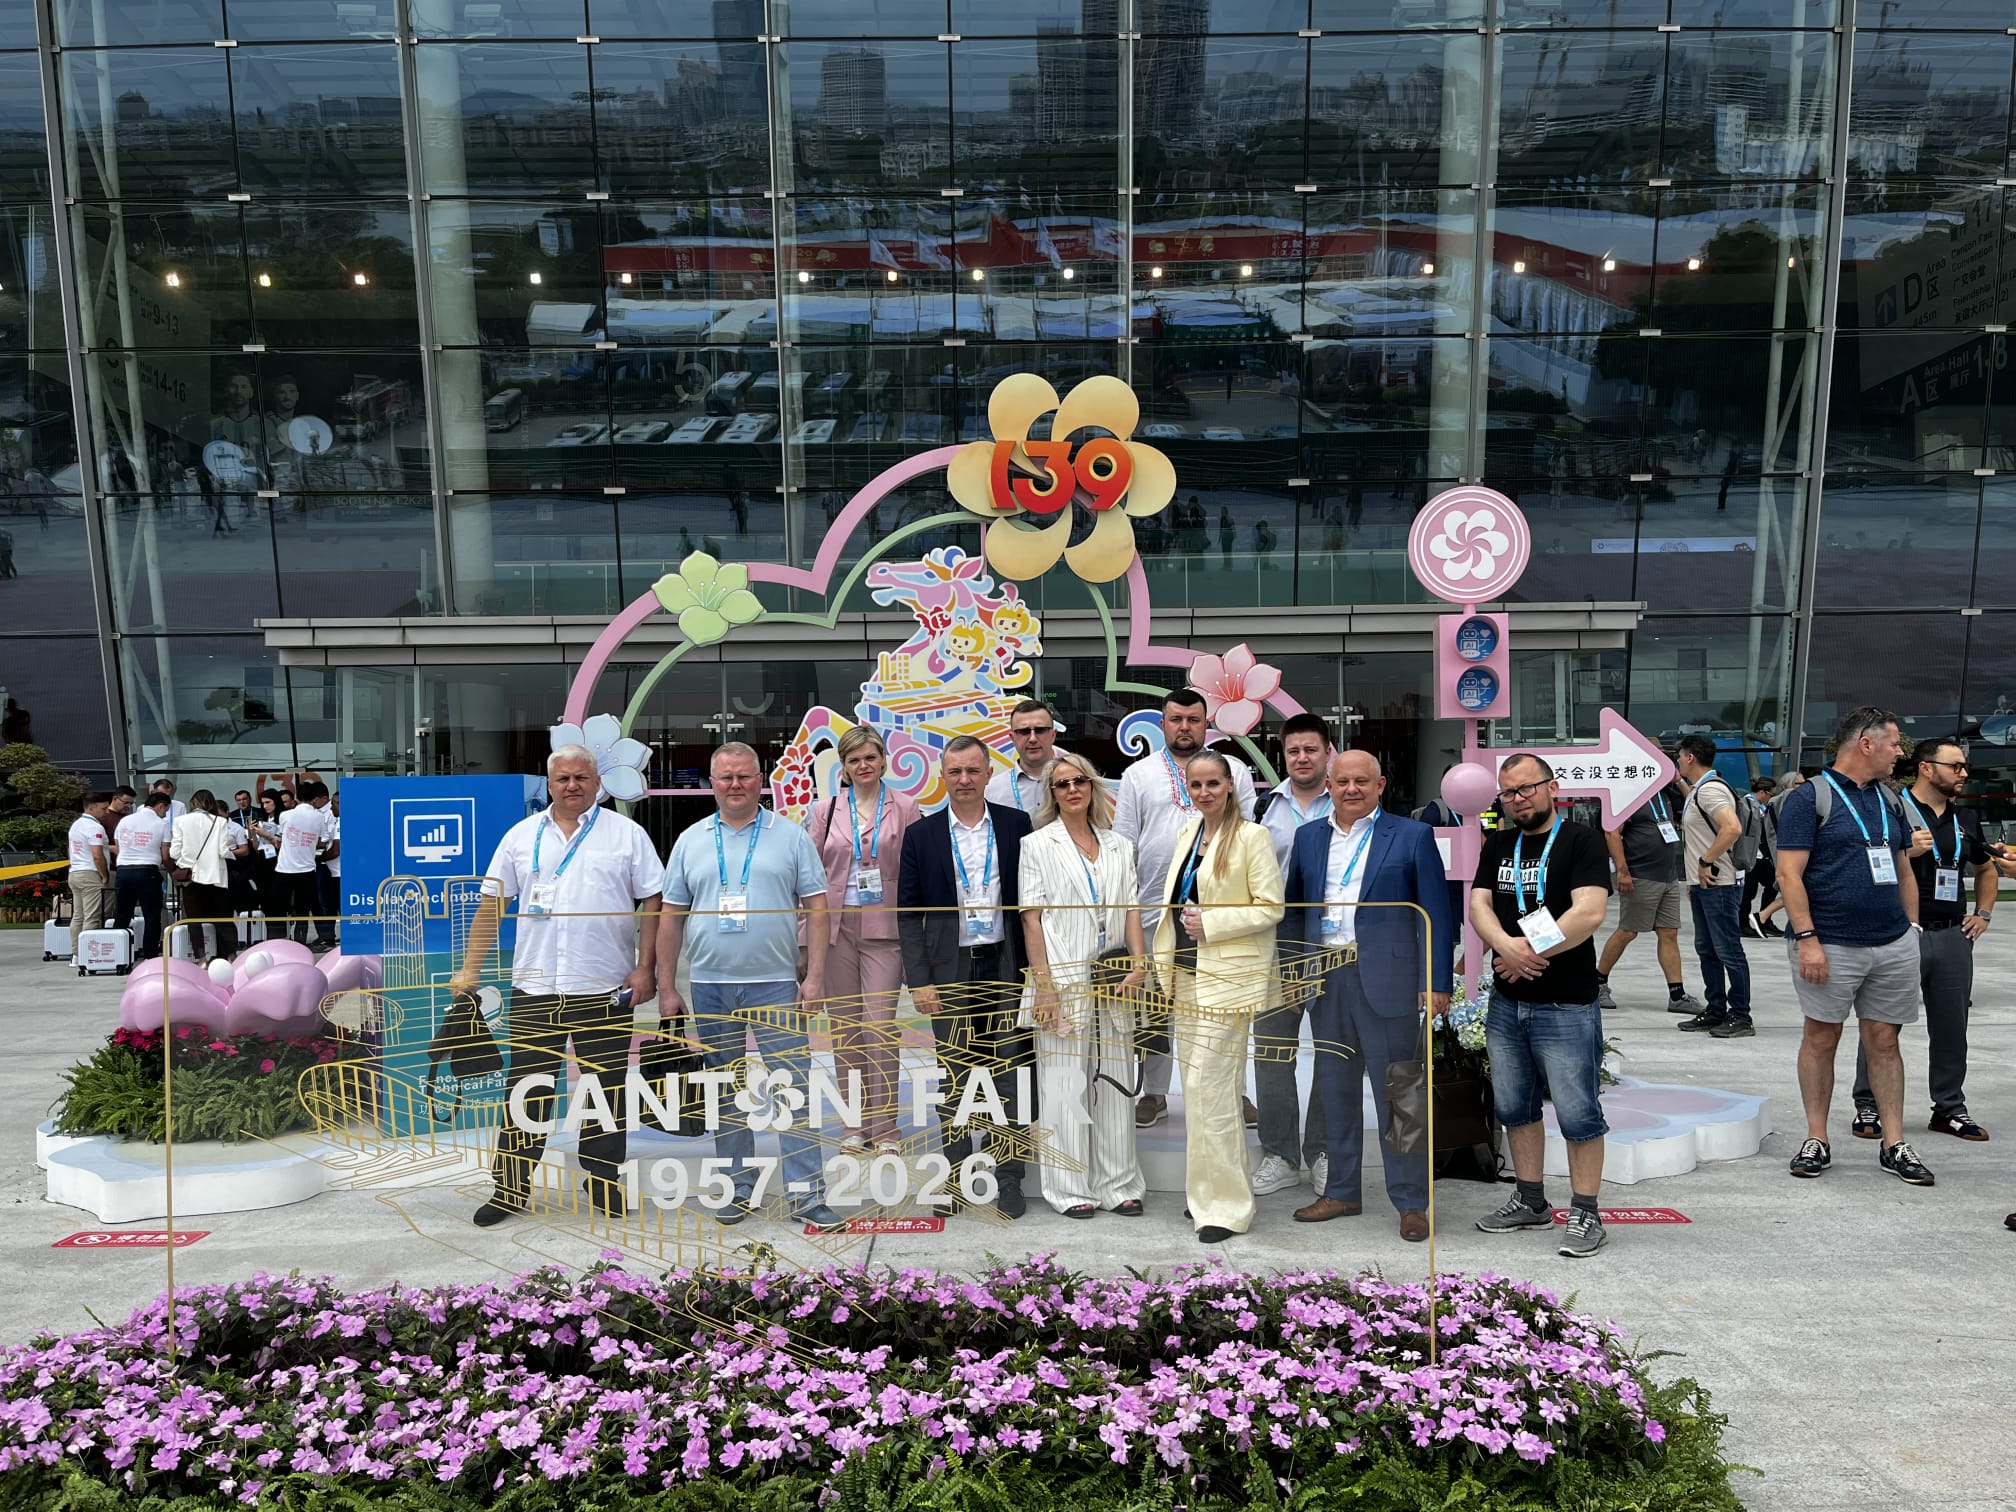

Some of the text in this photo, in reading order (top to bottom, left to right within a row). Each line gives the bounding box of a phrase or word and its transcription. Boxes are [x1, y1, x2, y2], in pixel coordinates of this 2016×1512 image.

[1925, 258, 1946, 277] Area
[1904, 273, 1922, 314] D
[1927, 276, 1940, 301] 区
[153, 304, 179, 335] 9-13
[1949, 350, 1969, 370] Hall
[154, 369, 186, 402] 14-16
[1900, 374, 1921, 414] A
[1926, 378, 1941, 404] 区
[988, 437, 1135, 514] 139
[1554, 765, 1656, 780] 交会没空想你
[1498, 869, 1539, 882] ADSOR
[1501, 860, 1541, 868] PAENTA
[418, 1079, 484, 1093] Tchnical
[911, 1066, 1095, 1127] FAIR
